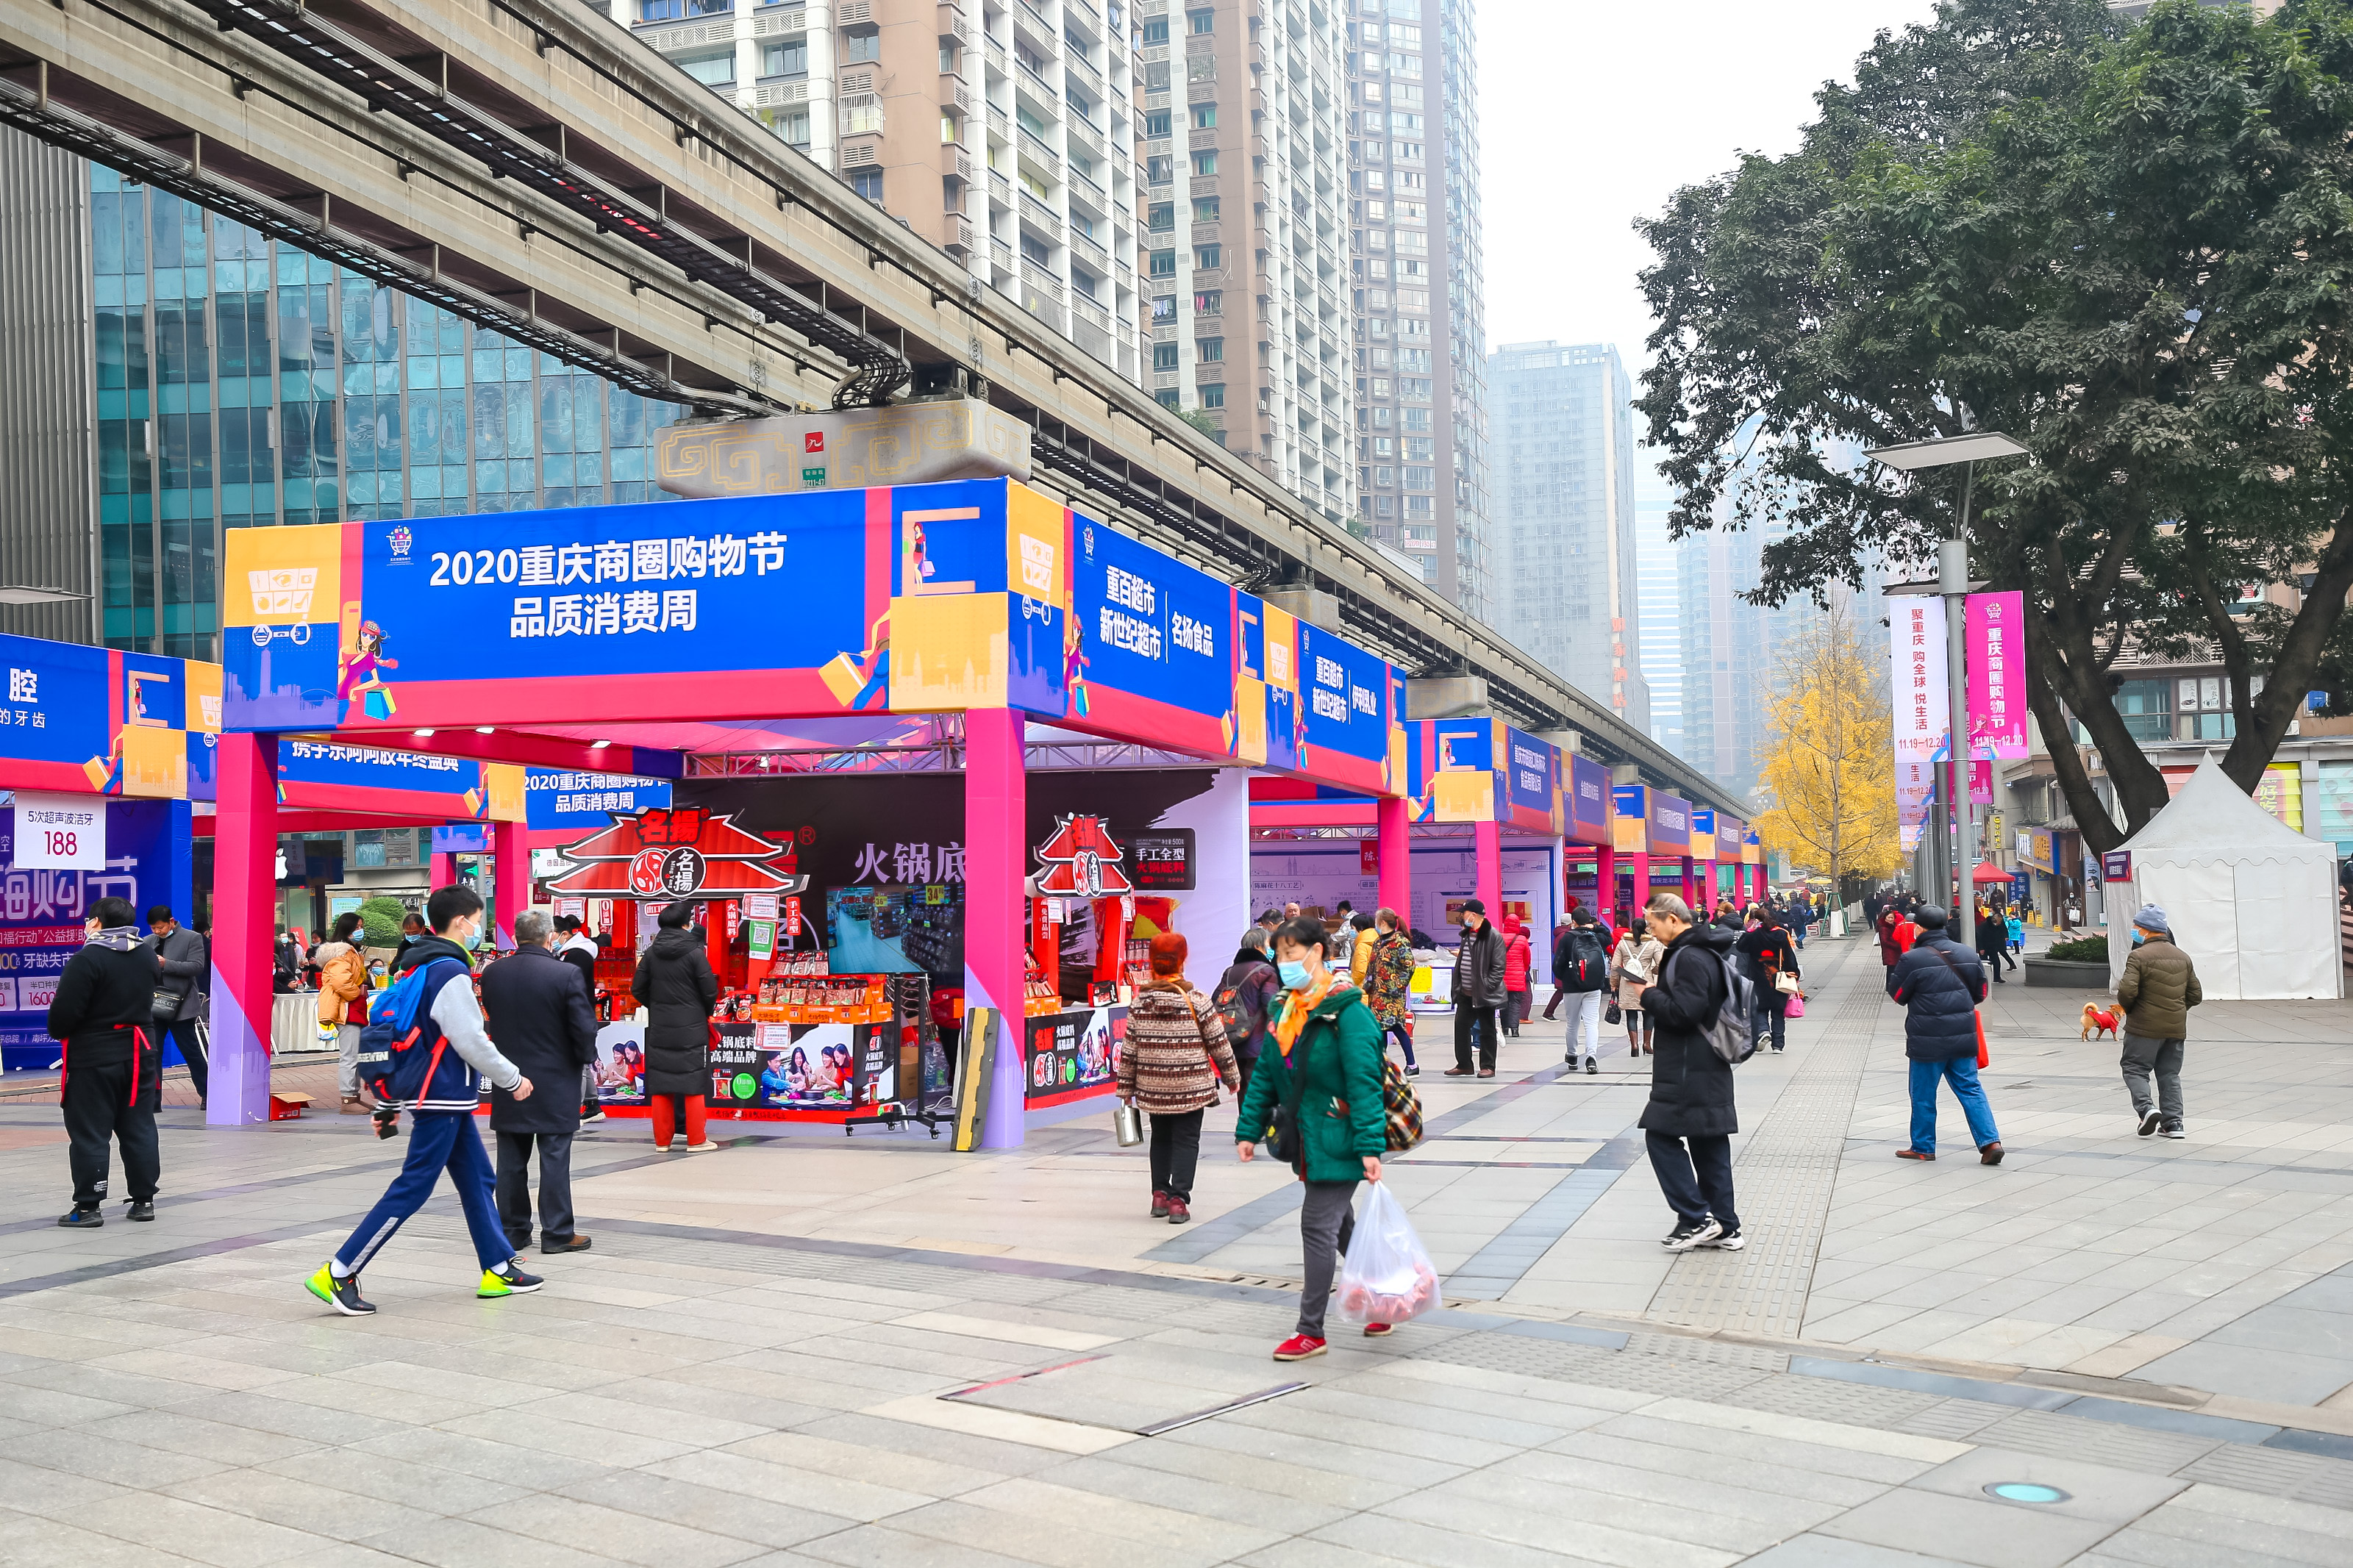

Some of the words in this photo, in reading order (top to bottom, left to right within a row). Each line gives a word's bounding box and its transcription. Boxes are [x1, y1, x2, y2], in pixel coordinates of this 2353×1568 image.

[429, 531, 787, 587] 2020重庆商圈购物节
[1107, 565, 1155, 616] 重百超市
[510, 589, 697, 638] 品质消费周
[1911, 609, 1924, 645] 聚重庆
[1100, 606, 1161, 661] 新世纪超市
[1171, 611, 1213, 658] 名扬食品
[9, 667, 38, 703] 腔
[1315, 655, 1343, 690] 重百超市
[1913, 651, 1926, 687] 购全球
[1987, 627, 2005, 728] 重庆商圈购物节
[1313, 686, 1346, 723] 新世纪超市
[1914, 693, 1927, 730] 悦生活
[28, 811, 93, 826] 5次超声波洁牙
[556, 792, 634, 813] 品质消费周
[45, 831, 77, 856] 188
[1135, 848, 1185, 861] 手工全型
[675, 850, 694, 892] 名揚
[853, 842, 965, 884] 火锅底
[1136, 862, 1185, 873] 火锅底料
[726, 903, 737, 936] 火锅底料
[788, 901, 799, 934] 手工全型
[155, 998, 174, 1008] GUCCI
[710, 1050, 757, 1064] 高端品牌
